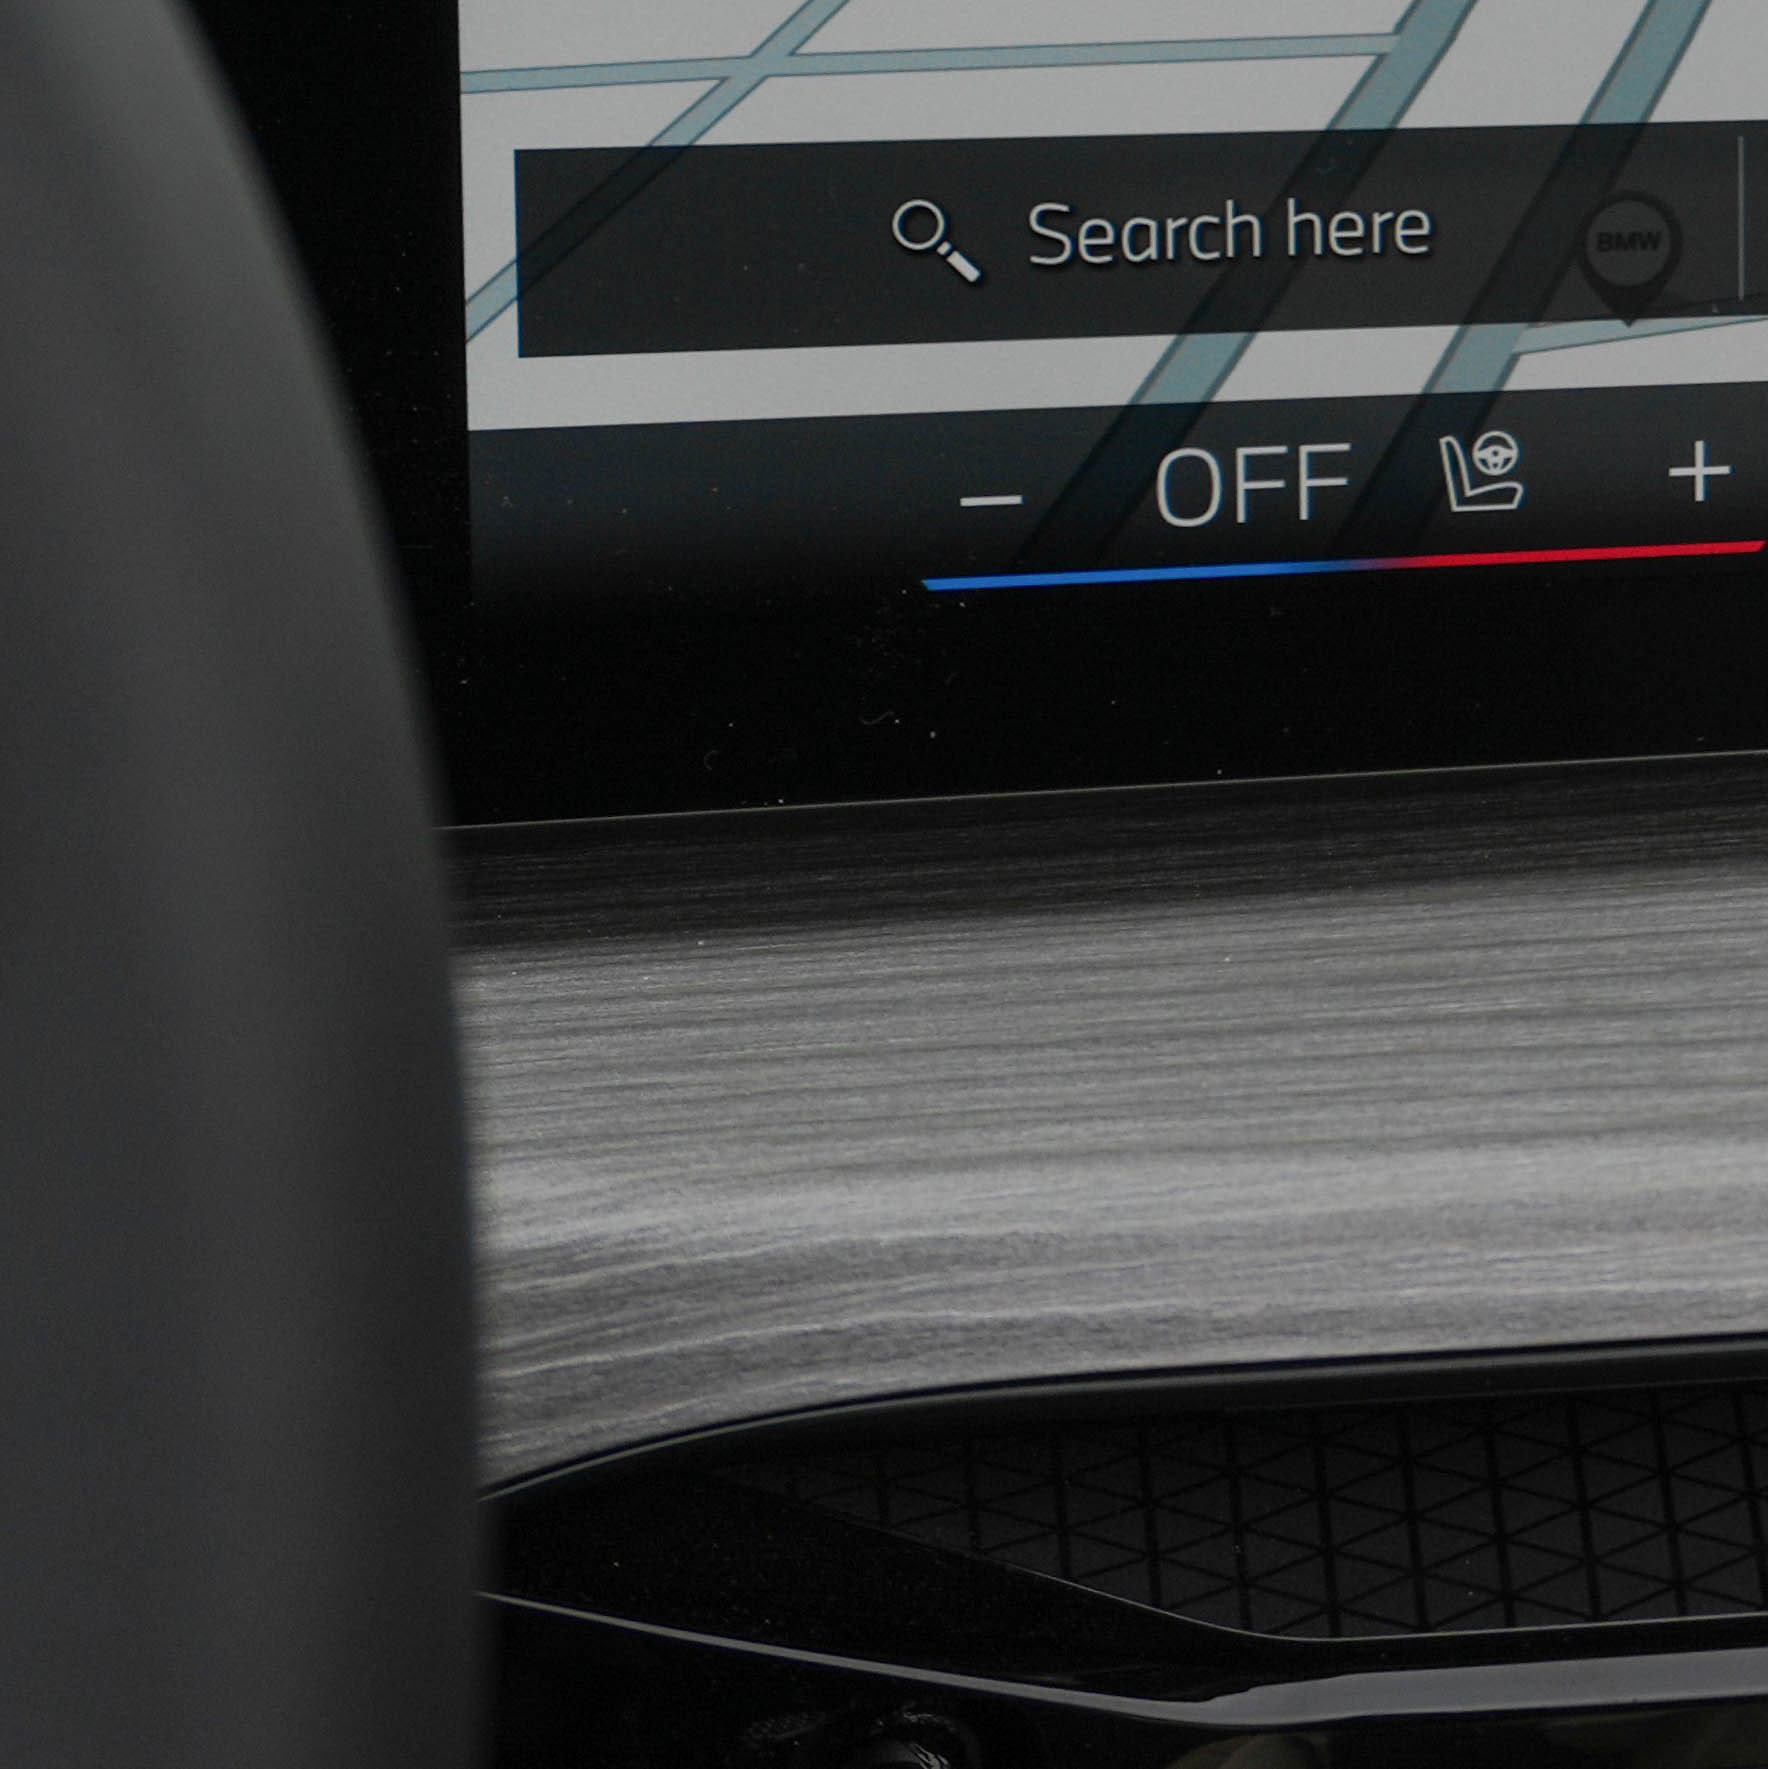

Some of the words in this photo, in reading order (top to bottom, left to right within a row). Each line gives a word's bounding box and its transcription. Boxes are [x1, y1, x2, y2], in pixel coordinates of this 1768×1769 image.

[1029, 199, 1262, 266] Search
[1286, 197, 1431, 256] here
[1597, 232, 1661, 252] BMW
[1157, 442, 1352, 528] OFF
